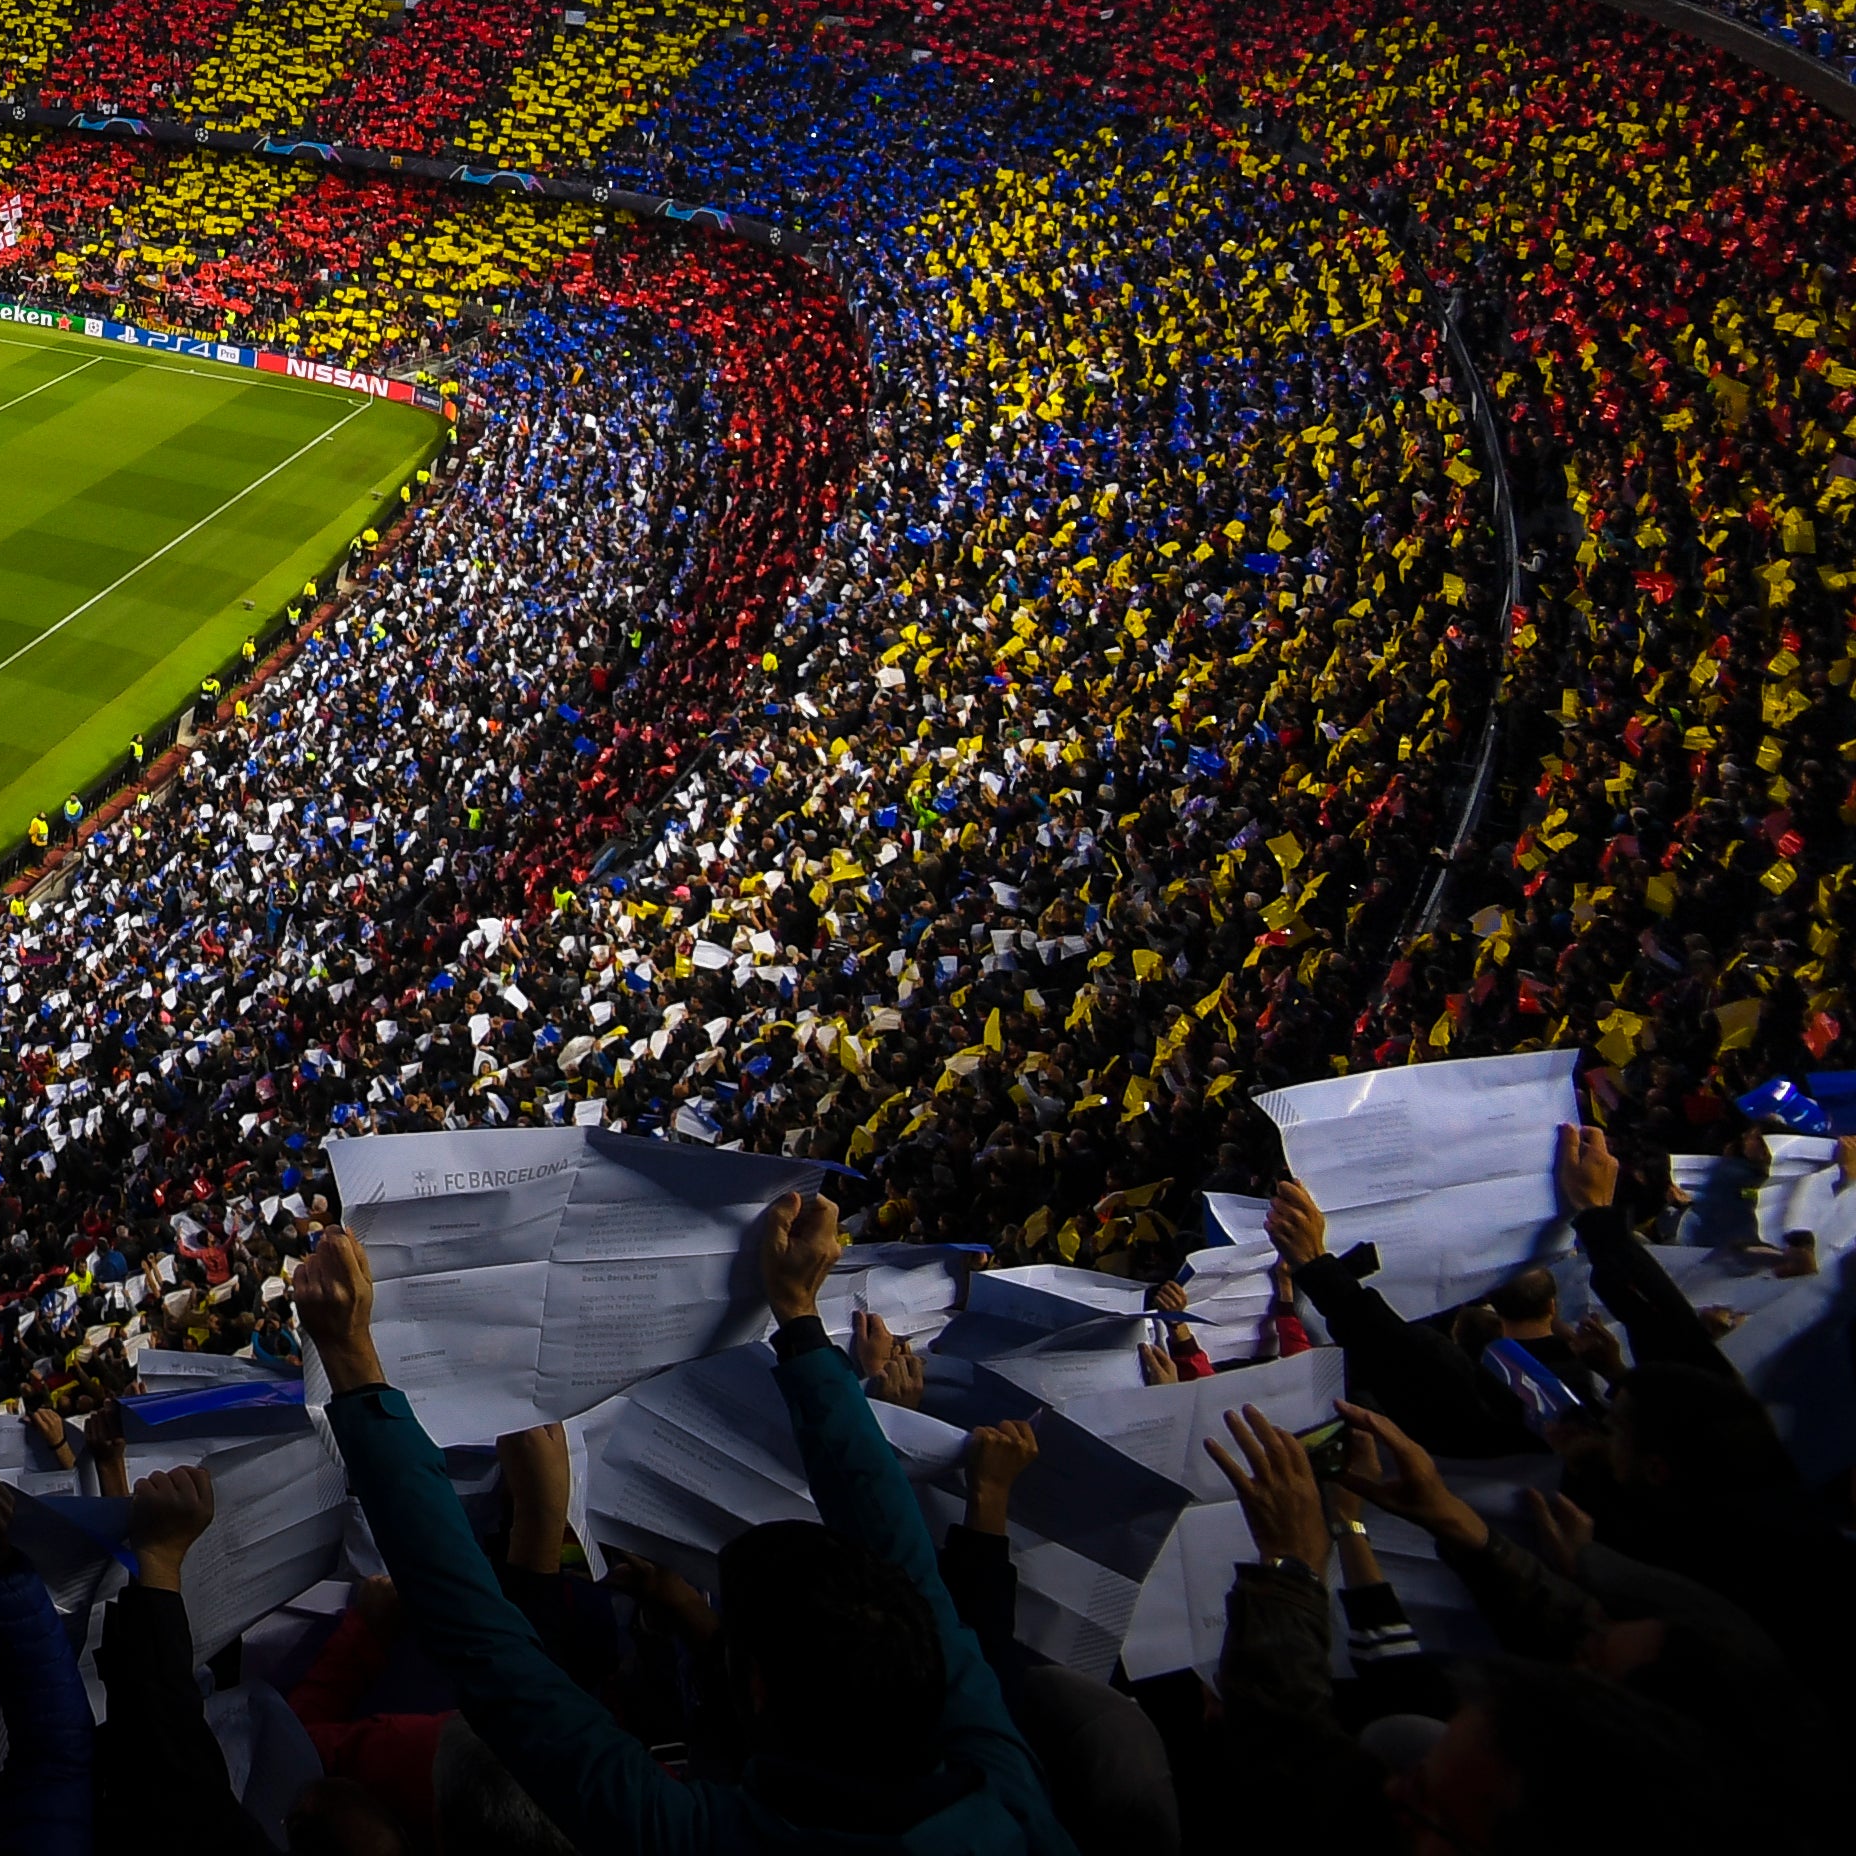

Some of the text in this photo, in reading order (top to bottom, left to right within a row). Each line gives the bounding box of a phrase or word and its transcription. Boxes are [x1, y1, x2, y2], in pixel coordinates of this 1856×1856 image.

[147, 331, 236, 360] PS4 Pro
[286, 358, 389, 398] NISSAN
[444, 1158, 570, 1192] FC BARCELONA
